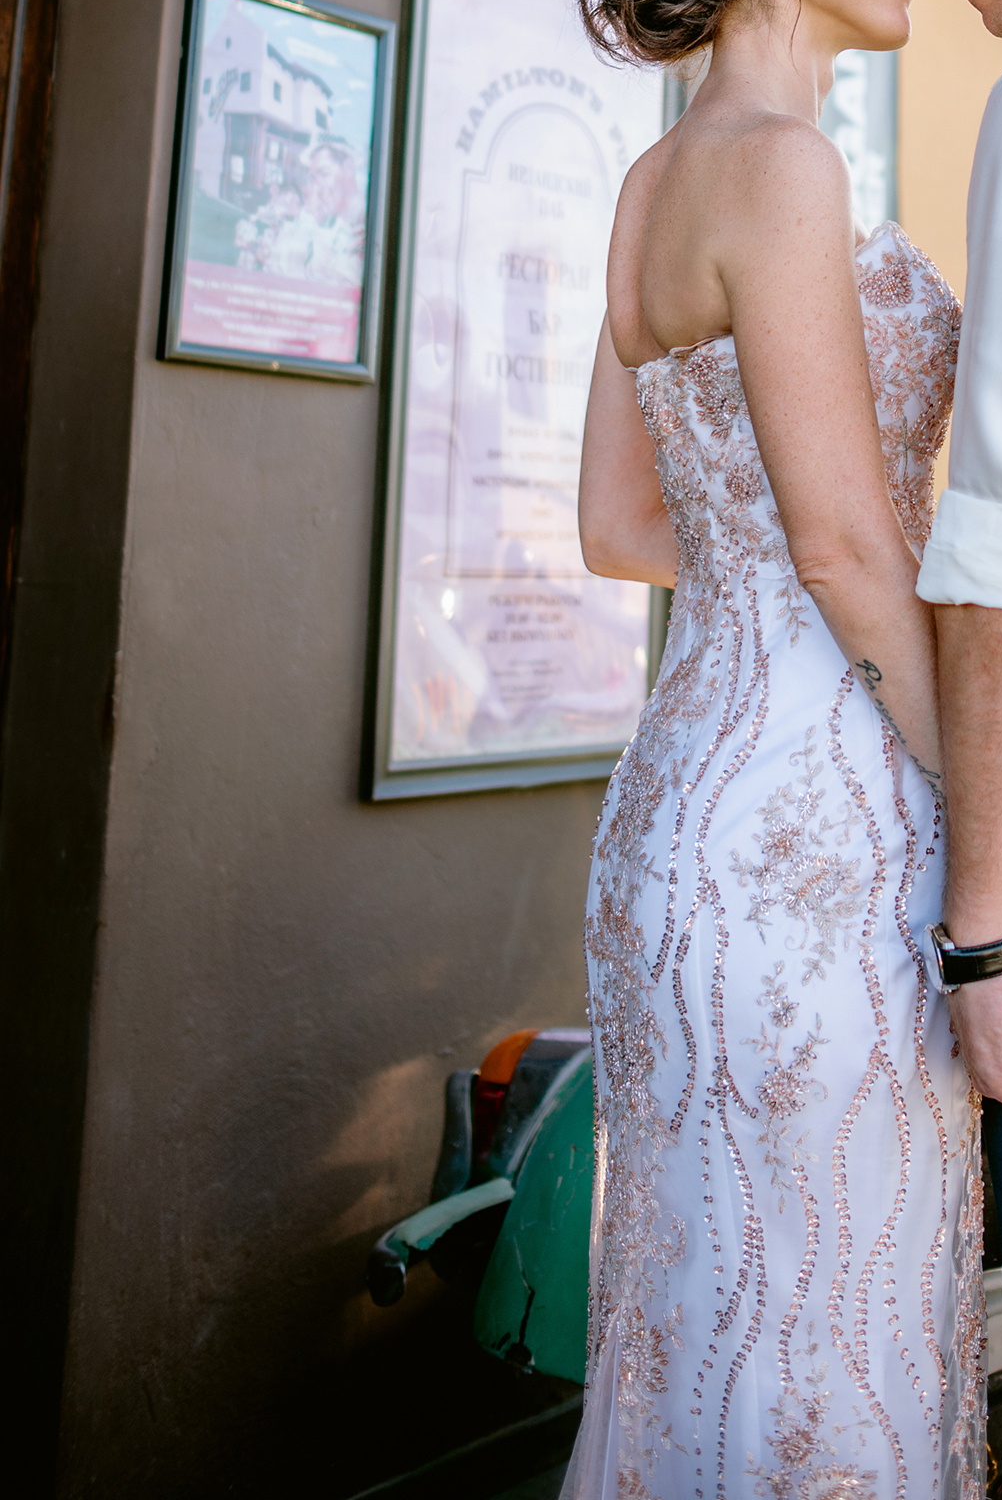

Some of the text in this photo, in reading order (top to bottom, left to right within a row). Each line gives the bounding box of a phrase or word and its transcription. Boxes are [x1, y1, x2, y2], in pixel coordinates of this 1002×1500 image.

[496, 251, 590, 291] РЕСТОРАН
[528, 309, 562, 338] БАР
[855, 658, 882, 693] Per
